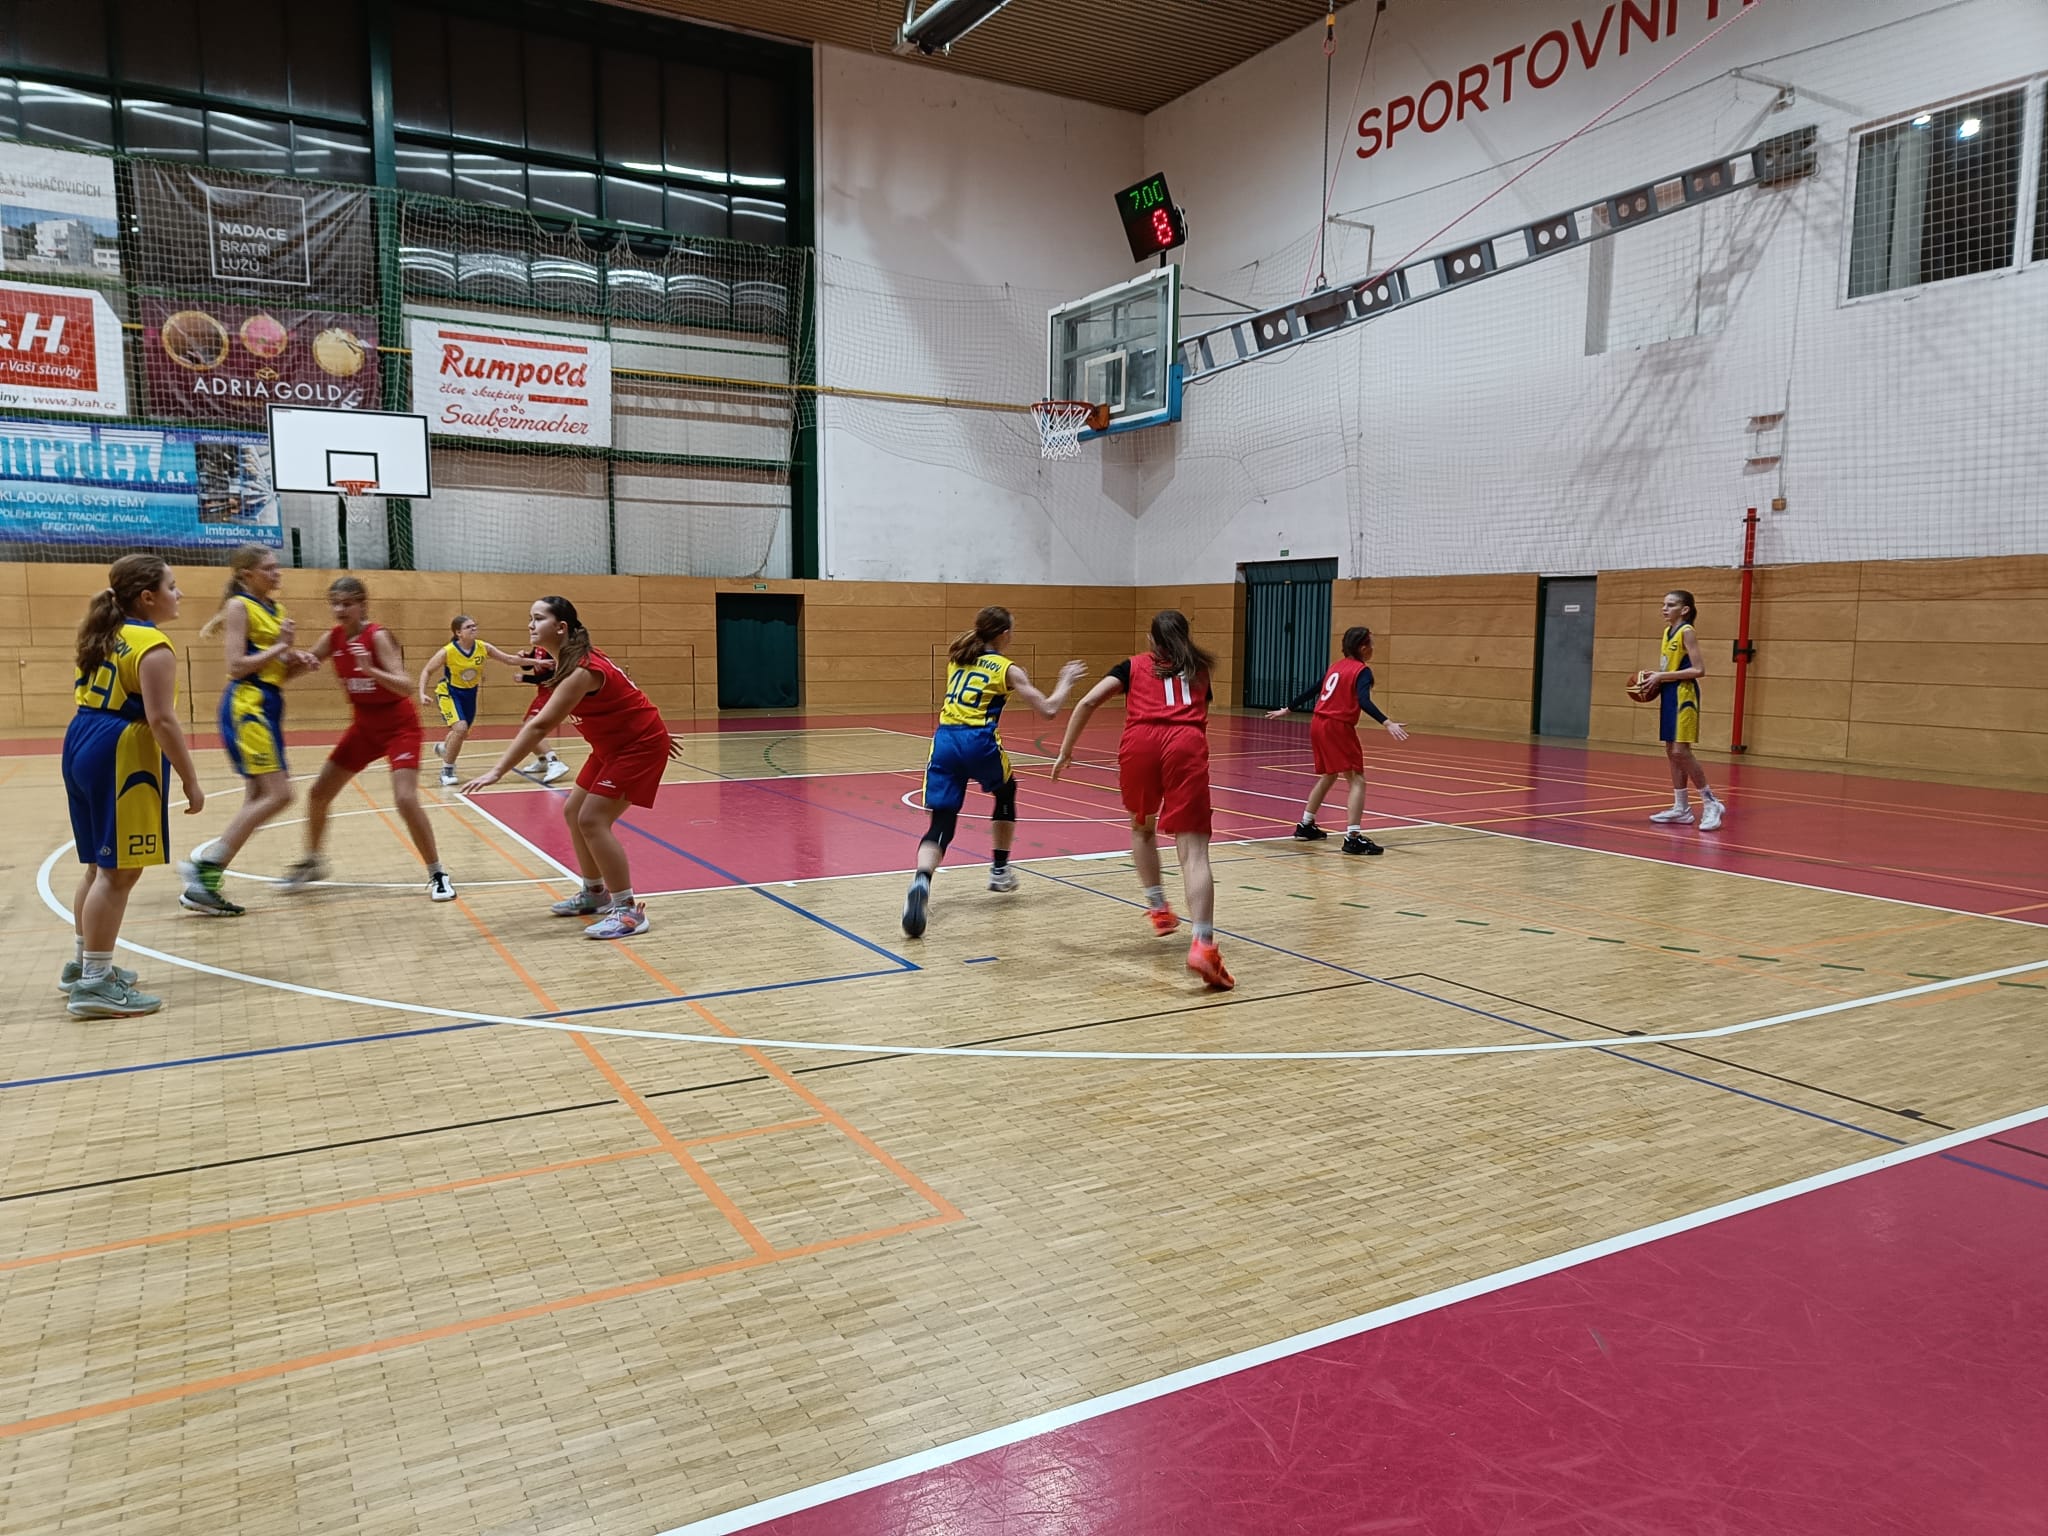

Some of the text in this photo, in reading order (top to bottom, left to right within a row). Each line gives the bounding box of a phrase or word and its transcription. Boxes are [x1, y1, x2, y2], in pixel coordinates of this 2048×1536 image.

[219, 221, 287, 241] NADACE
[1153, 209, 1172, 244] 8
[221, 256, 261, 272] LUŽŮ
[38, 363, 81, 380] stavby
[440, 344, 588, 388] Rumpold
[193, 377, 342, 401] ADRIA GOLD
[472, 387, 525, 404] skupiny
[33, 396, 117, 410] www.3vah.cz
[440, 403, 589, 435] Saubermacher
[945, 668, 990, 708] 46
[1163, 670, 1192, 706] 11
[1320, 672, 1340, 701] 9
[129, 834, 157, 855] 29
